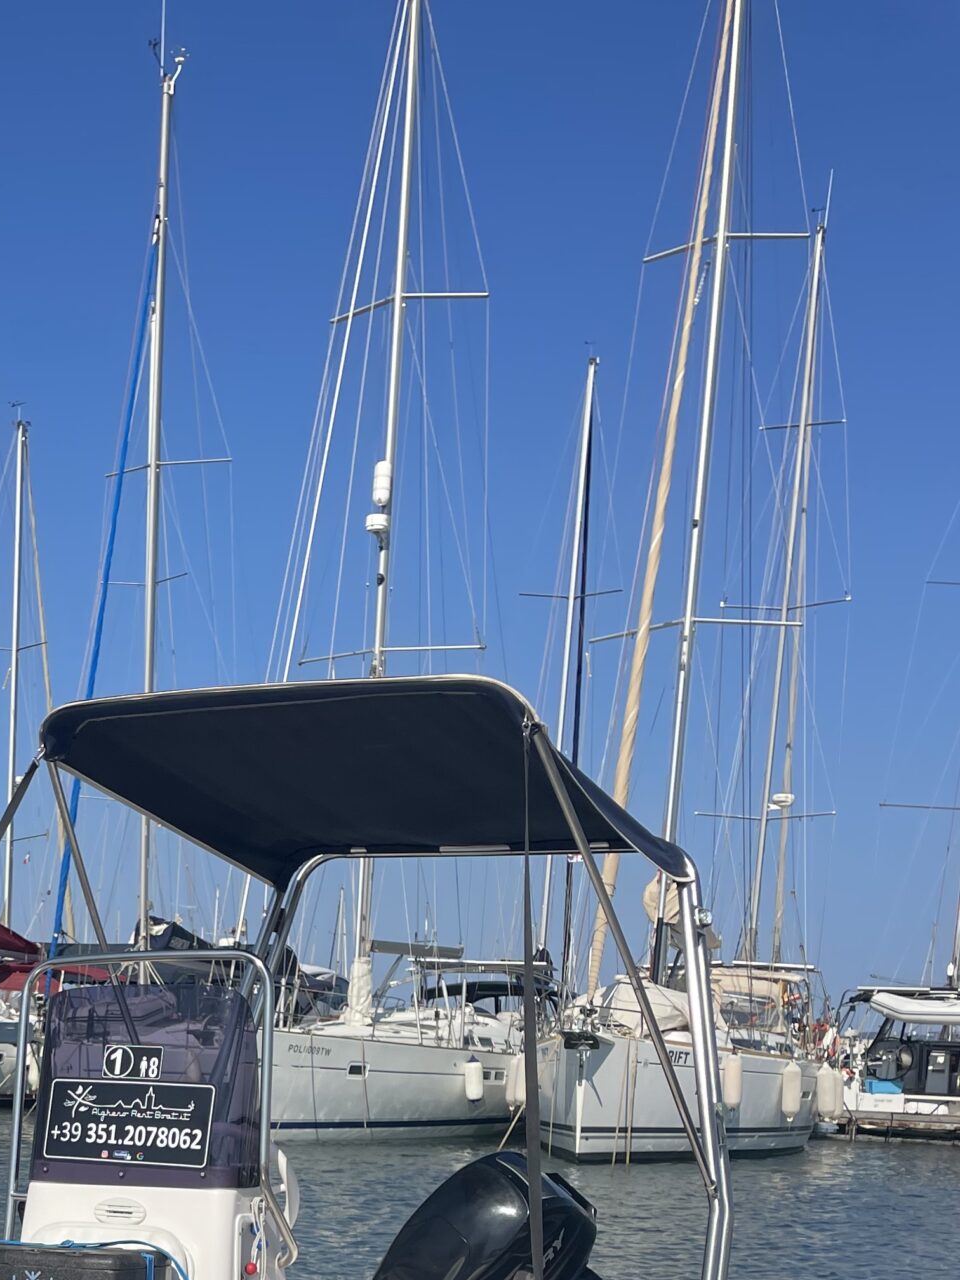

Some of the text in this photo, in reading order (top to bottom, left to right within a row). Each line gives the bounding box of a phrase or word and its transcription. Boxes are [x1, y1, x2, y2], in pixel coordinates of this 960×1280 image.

[110, 1048, 159, 1078] 1 8
[91, 1108, 129, 1122] Alghero
[130, 1109, 154, 1119] Rent
[51, 1122, 202, 1150] +39 351.2078062
